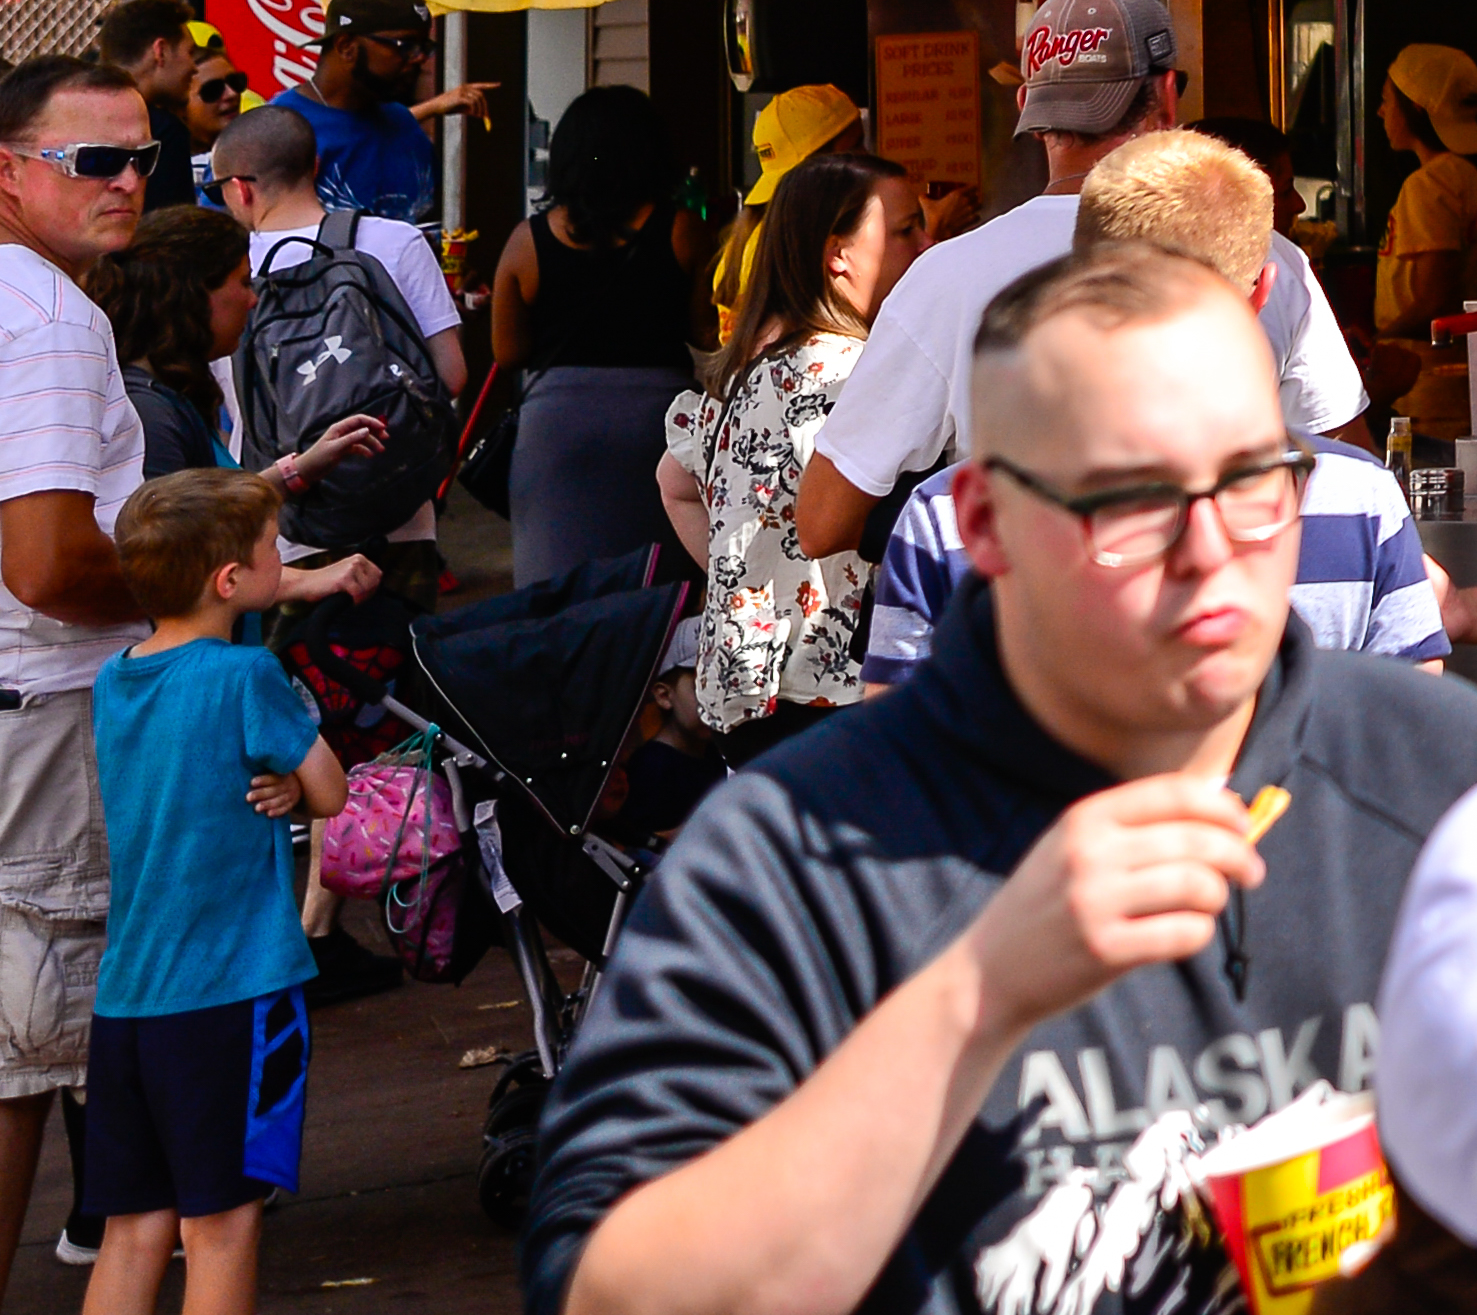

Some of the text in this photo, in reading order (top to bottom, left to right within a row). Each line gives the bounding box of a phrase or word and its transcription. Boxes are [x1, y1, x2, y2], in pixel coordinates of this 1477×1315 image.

[1026, 26, 1113, 80] Ranger
[1077, 54, 1108, 63] BOATS
[1017, 1001, 1382, 1142] ALASKA
